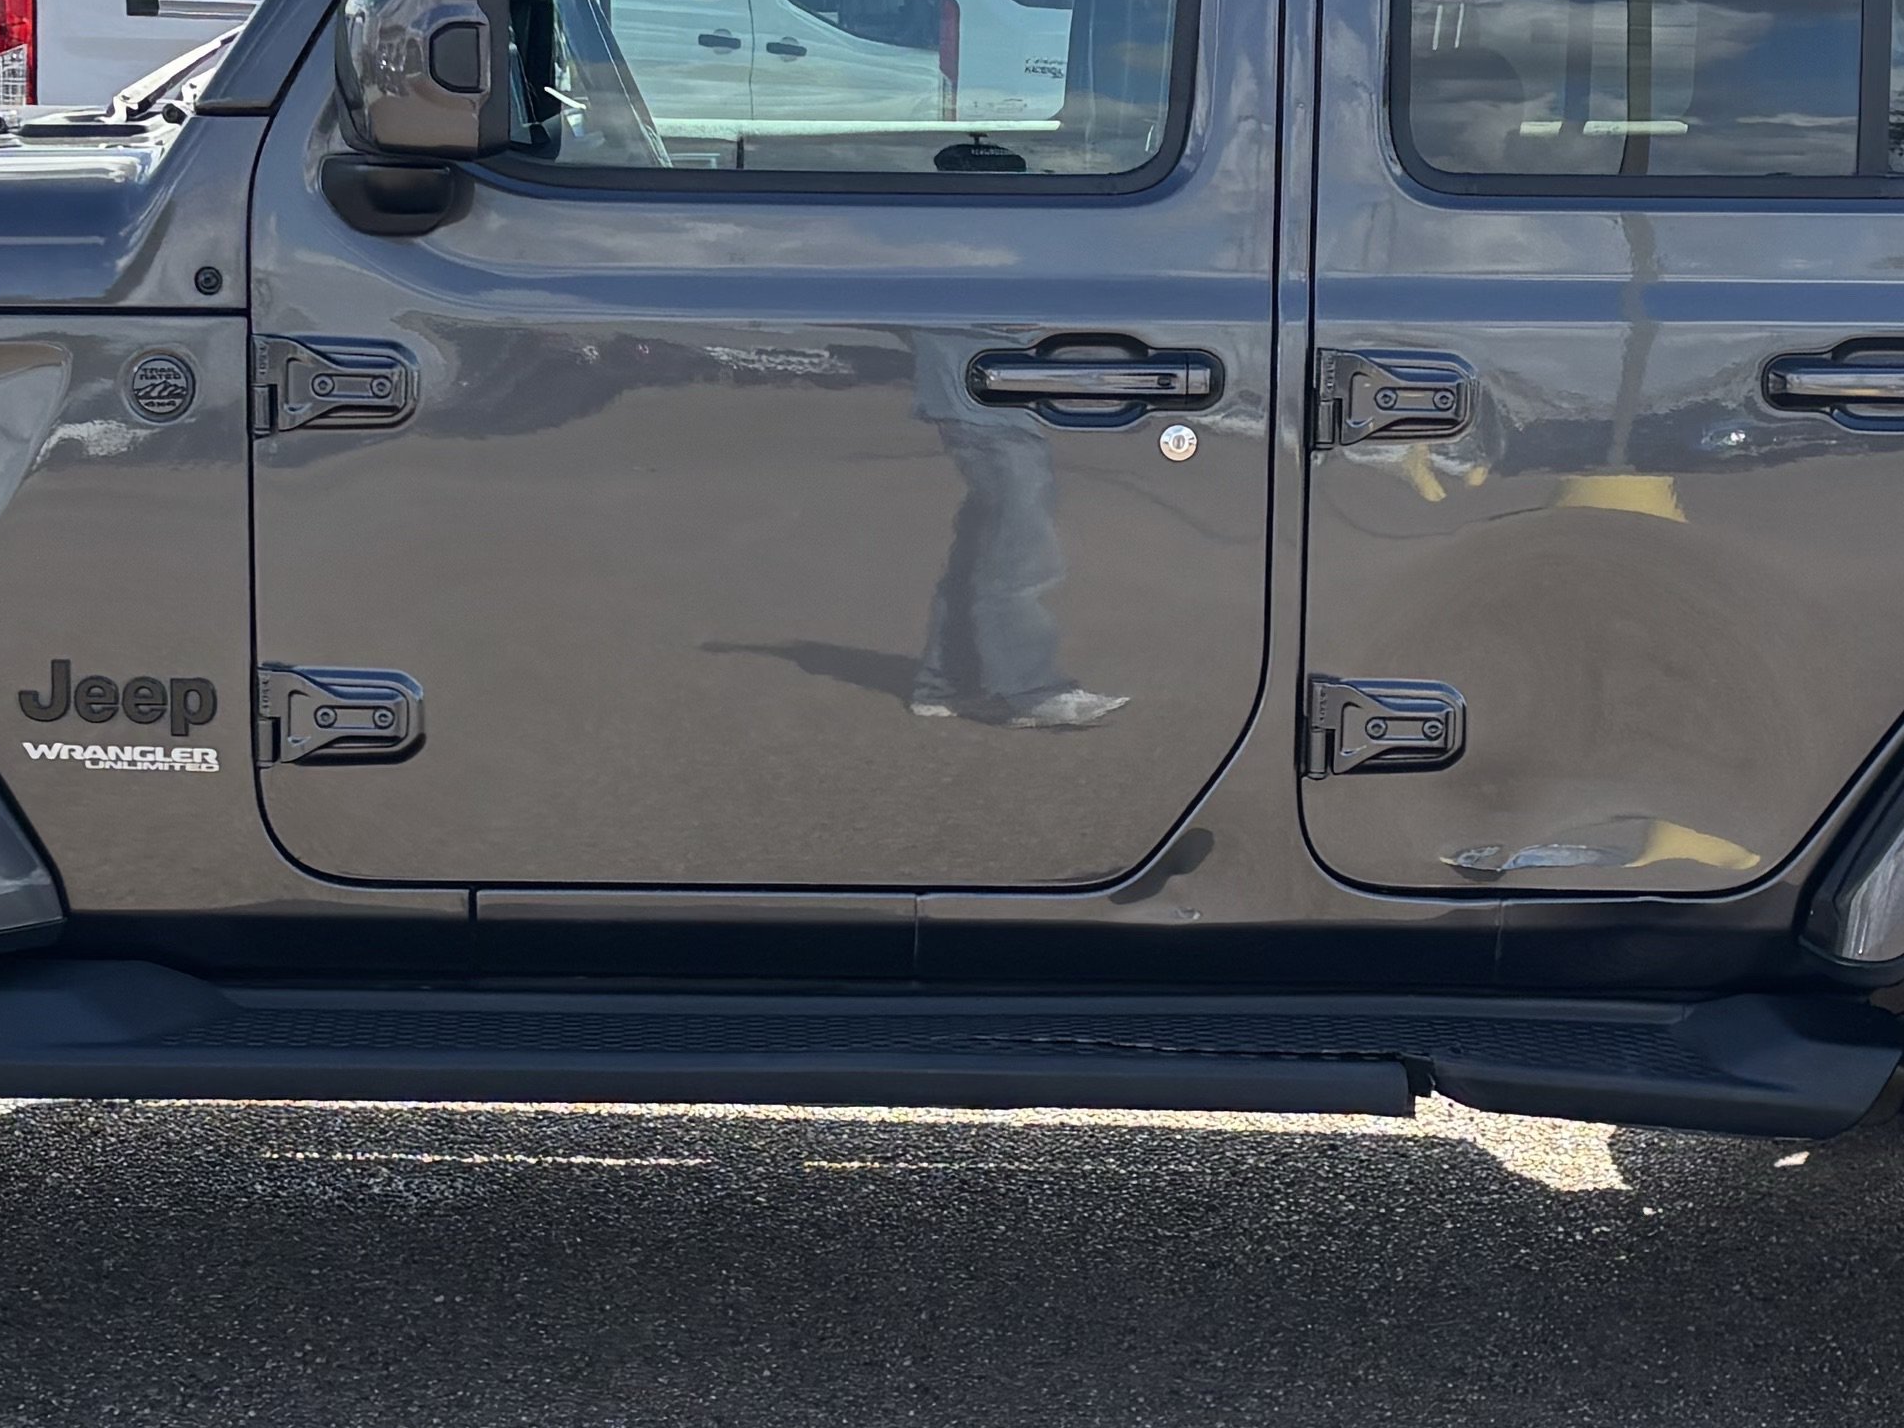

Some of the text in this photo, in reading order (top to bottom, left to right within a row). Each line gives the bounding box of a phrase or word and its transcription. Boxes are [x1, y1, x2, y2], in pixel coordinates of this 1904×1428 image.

[18, 658, 218, 737] Jeep
[22, 741, 219, 765] WRANGLER
[84, 759, 220, 773] UNLIMITED
